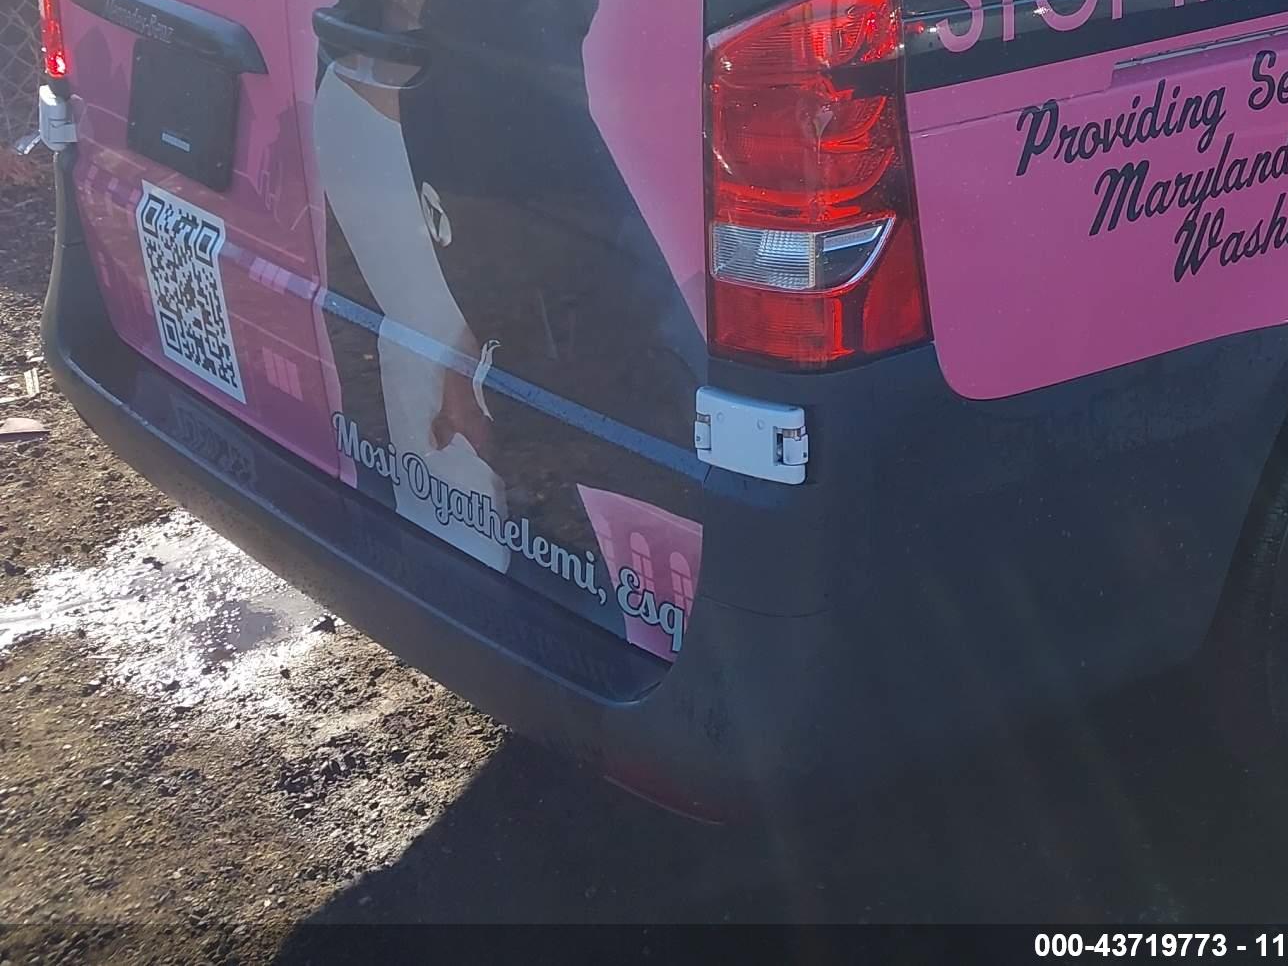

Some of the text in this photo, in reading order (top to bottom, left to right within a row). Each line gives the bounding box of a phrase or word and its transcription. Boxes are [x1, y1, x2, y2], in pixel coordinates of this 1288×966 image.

[1016, 79, 1226, 176] Providing
[331, 411, 685, 652] Mosi Oyathelemi, Esq
